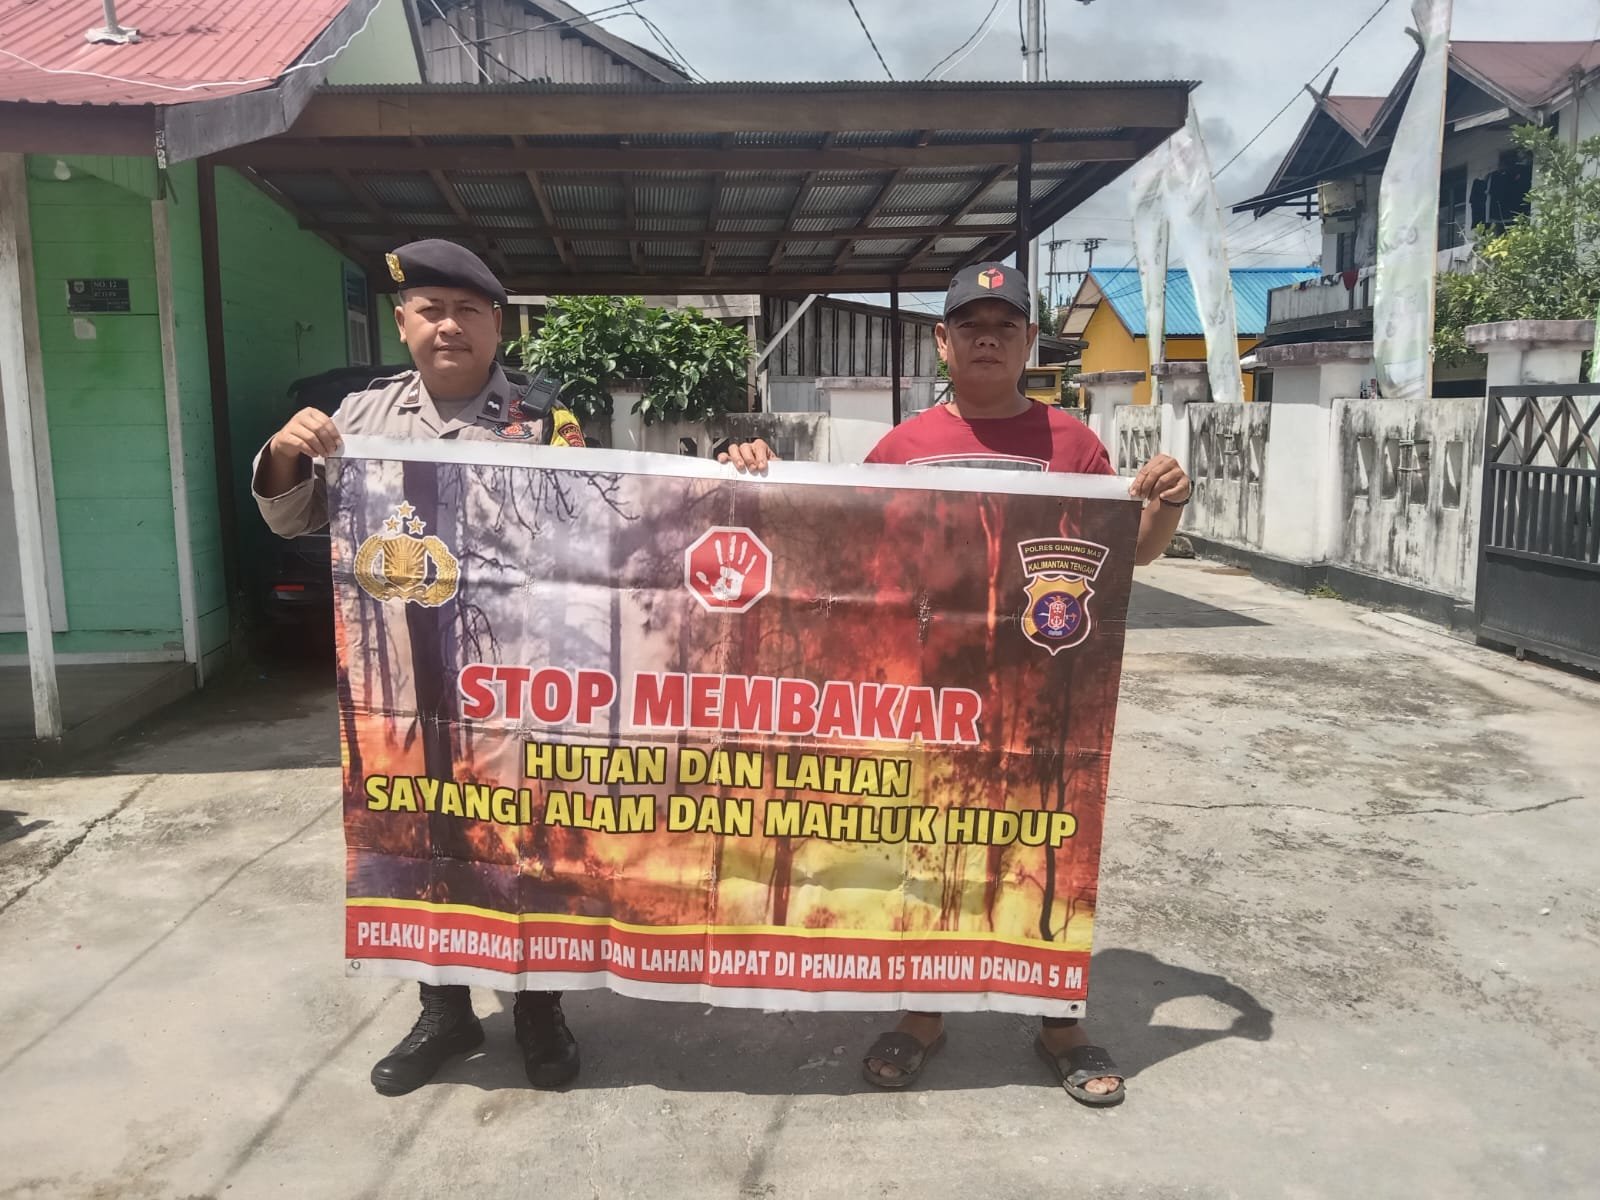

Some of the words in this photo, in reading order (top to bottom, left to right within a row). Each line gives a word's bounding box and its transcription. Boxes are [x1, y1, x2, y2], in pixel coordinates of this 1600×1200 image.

[1025, 544, 1053, 554] POLRES
[1055, 544, 1086, 554] GUNUNG
[1028, 560, 1069, 572] KALIMANTAN
[1070, 562, 1095, 576] TENGAH
[457, 663, 617, 725] STOP
[632, 671, 983, 745] MEMBAKAR
[525, 742, 667, 784] HUTAN
[678, 748, 765, 789] DAN
[775, 752, 911, 797] LAHAN
[365, 775, 532, 826] SAYANGI
[544, 791, 657, 833] ALAM
[667, 794, 752, 837] DAN
[763, 799, 939, 844] MAHLUK
[945, 809, 1078, 848] HIDUP
[357, 921, 425, 949] PELAKU
[428, 927, 524, 962] PEMBAKAR
[530, 936, 595, 962] HUTAN
[600, 938, 635, 969] DAN
[641, 948, 704, 973] LAHAN
[708, 949, 770, 976] DAPAT
[775, 952, 795, 978] DI
[801, 953, 882, 980] PENJARA
[887, 956, 905, 981] 15
[910, 955, 974, 981] TAHUN
[979, 956, 1043, 985] DENDA
[1048, 965, 1059, 988] 5
[1065, 966, 1083, 990] M
